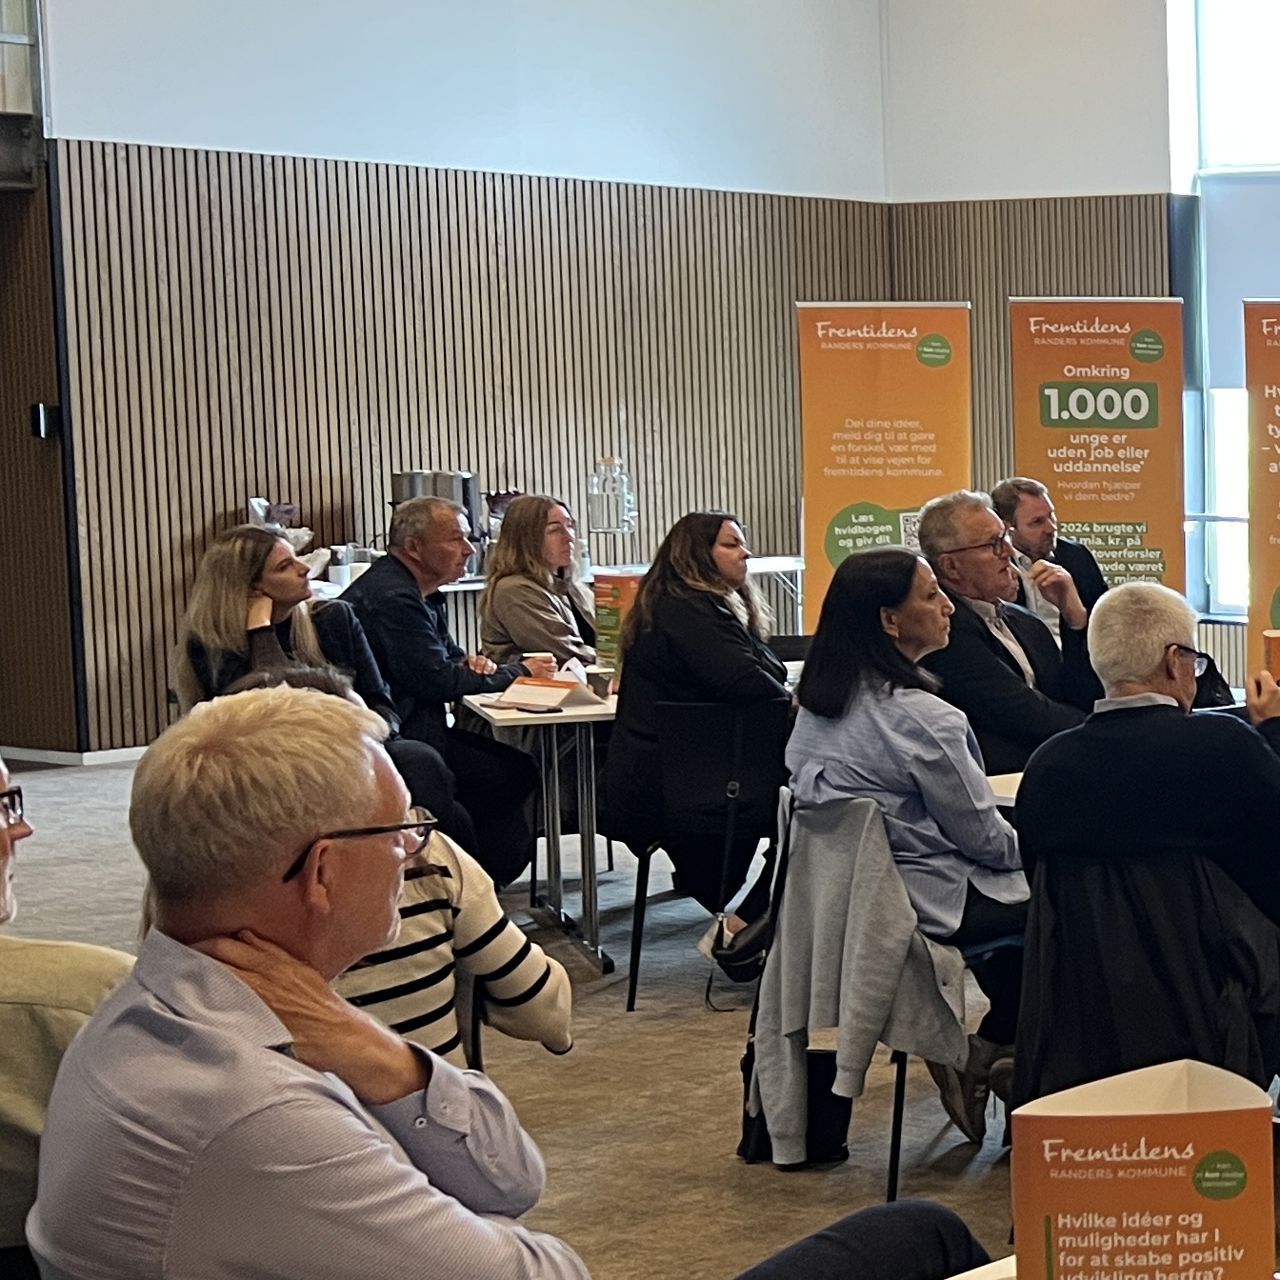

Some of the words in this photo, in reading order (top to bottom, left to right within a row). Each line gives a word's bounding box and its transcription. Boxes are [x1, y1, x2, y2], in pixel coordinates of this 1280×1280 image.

[816, 321, 918, 338] Fremtidens
[1028, 316, 1131, 334] Fremtidens
[821, 342, 864, 350] RANDERS
[866, 342, 912, 350] KOMMUNE
[1080, 338, 1125, 346] KOMMUNE
[1063, 365, 1130, 380] Omkring
[1044, 388, 1150, 421] 1.000
[845, 419, 864, 428] Del
[866, 419, 891, 428] dine
[832, 432, 861, 440] meld
[864, 432, 882, 442] dig
[884, 432, 894, 440] til
[897, 432, 908, 440] at
[1070, 434, 1109, 446] unge
[1112, 434, 1128, 444] er
[830, 444, 845, 452] en
[848, 443, 886, 453] forskel,
[911, 444, 936, 452] med
[1047, 446, 1086, 458] uden
[1090, 445, 1114, 461] job
[1118, 446, 1150, 458] eller
[836, 456, 846, 464] til
[849, 456, 860, 464] at
[862, 456, 884, 464] vise
[886, 456, 915, 466] vejen
[917, 455, 932, 464] for
[824, 467, 884, 477] fremtidens
[886, 468, 944, 477] kommune.
[1057, 480, 1100, 489] Hvordan
[1102, 481, 1141, 491] hjælper
[1063, 492, 1073, 501] vi
[1074, 492, 1099, 501] dem
[1101, 492, 1135, 501] bedre?
[851, 514, 874, 523] Læs
[835, 524, 893, 535] hvidbogen
[1060, 523, 1090, 533] 2024
[1093, 523, 1133, 534] brugte
[1136, 522, 1147, 533] vi
[838, 538, 854, 547] og
[856, 536, 873, 546] giv
[875, 535, 890, 544] dit
[1108, 536, 1124, 545] kr.
[1127, 535, 1141, 547] på
[1128, 562, 1164, 571] været
[1042, 1136, 1195, 1162] Fremtidens
[1050, 1168, 1113, 1179] RANDERS
[1117, 1166, 1187, 1178] KOMMUNE
[1058, 1212, 1116, 1228] Hvilke
[1122, 1212, 1172, 1228] idéer
[1178, 1212, 1203, 1228] og
[1058, 1232, 1170, 1250] muligheder
[1176, 1229, 1208, 1245] har
[1214, 1228, 1220, 1242] I
[1058, 1252, 1085, 1267] for
[1090, 1252, 1110, 1267] at
[1114, 1251, 1172, 1267] skabe
[1178, 1245, 1244, 1267] positiv
